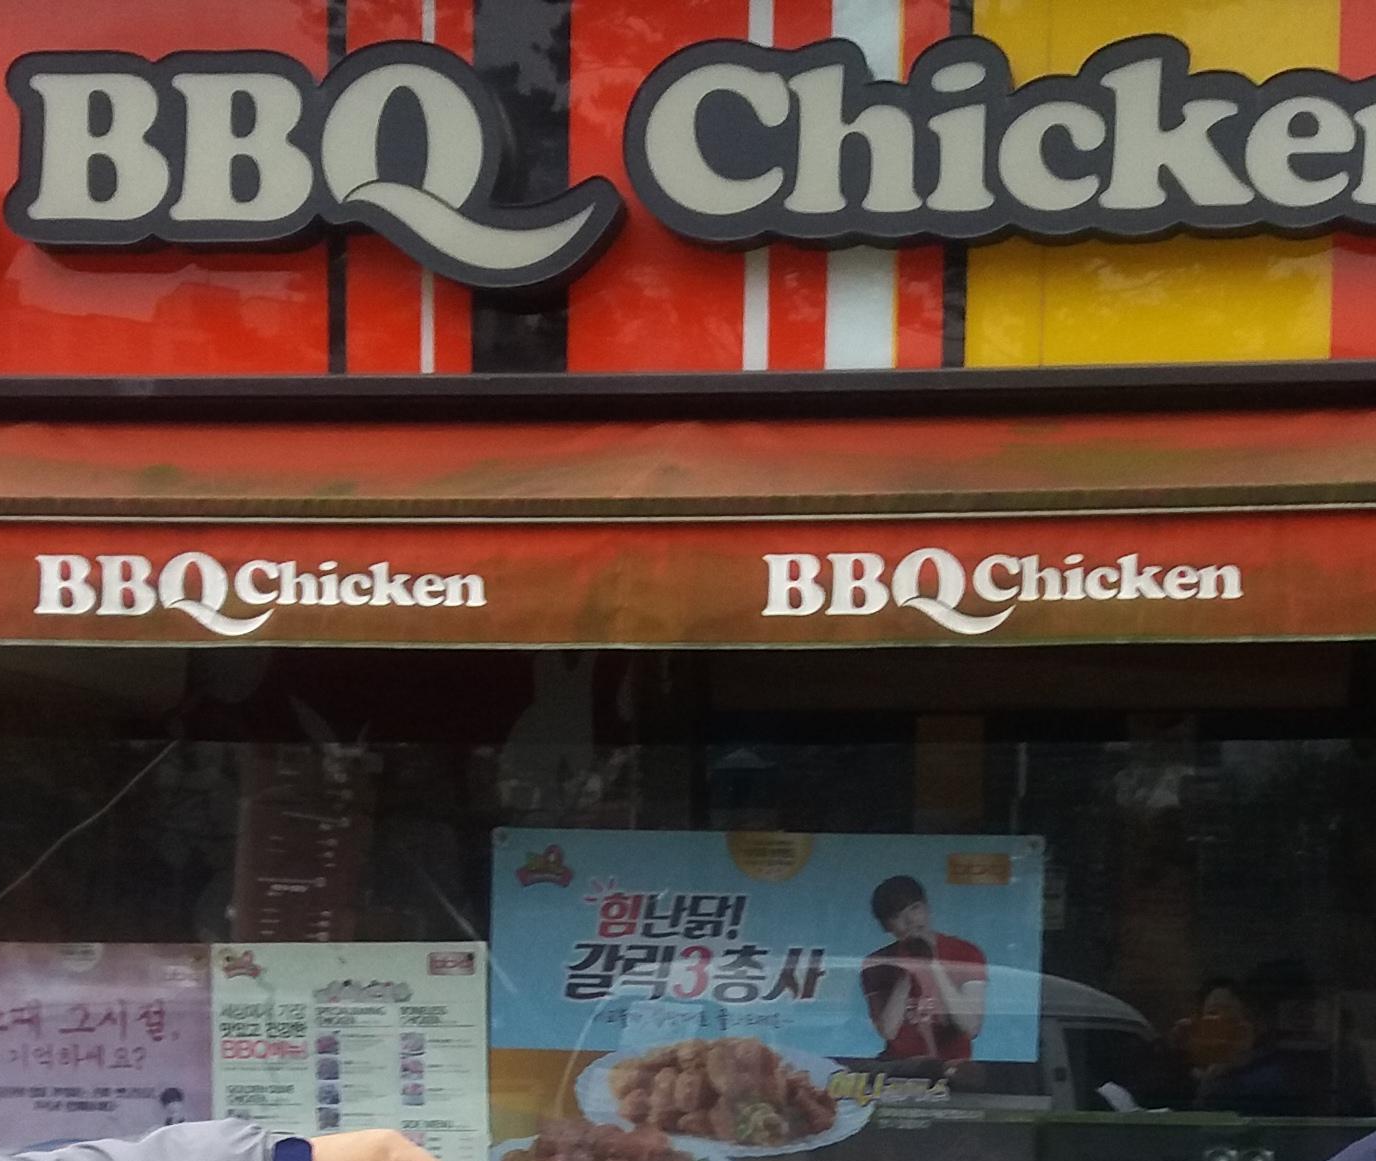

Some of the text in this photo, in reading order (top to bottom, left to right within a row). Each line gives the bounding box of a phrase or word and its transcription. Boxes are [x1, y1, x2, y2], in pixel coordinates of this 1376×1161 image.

[28, 60, 596, 271] BBQ
[35, 552, 487, 636] BBQ Chicken
[762, 547, 1242, 634] BBQ Chicken
[597, 892, 747, 940] 힘난닭!
[564, 942, 826, 1003] 갈릭3총사
